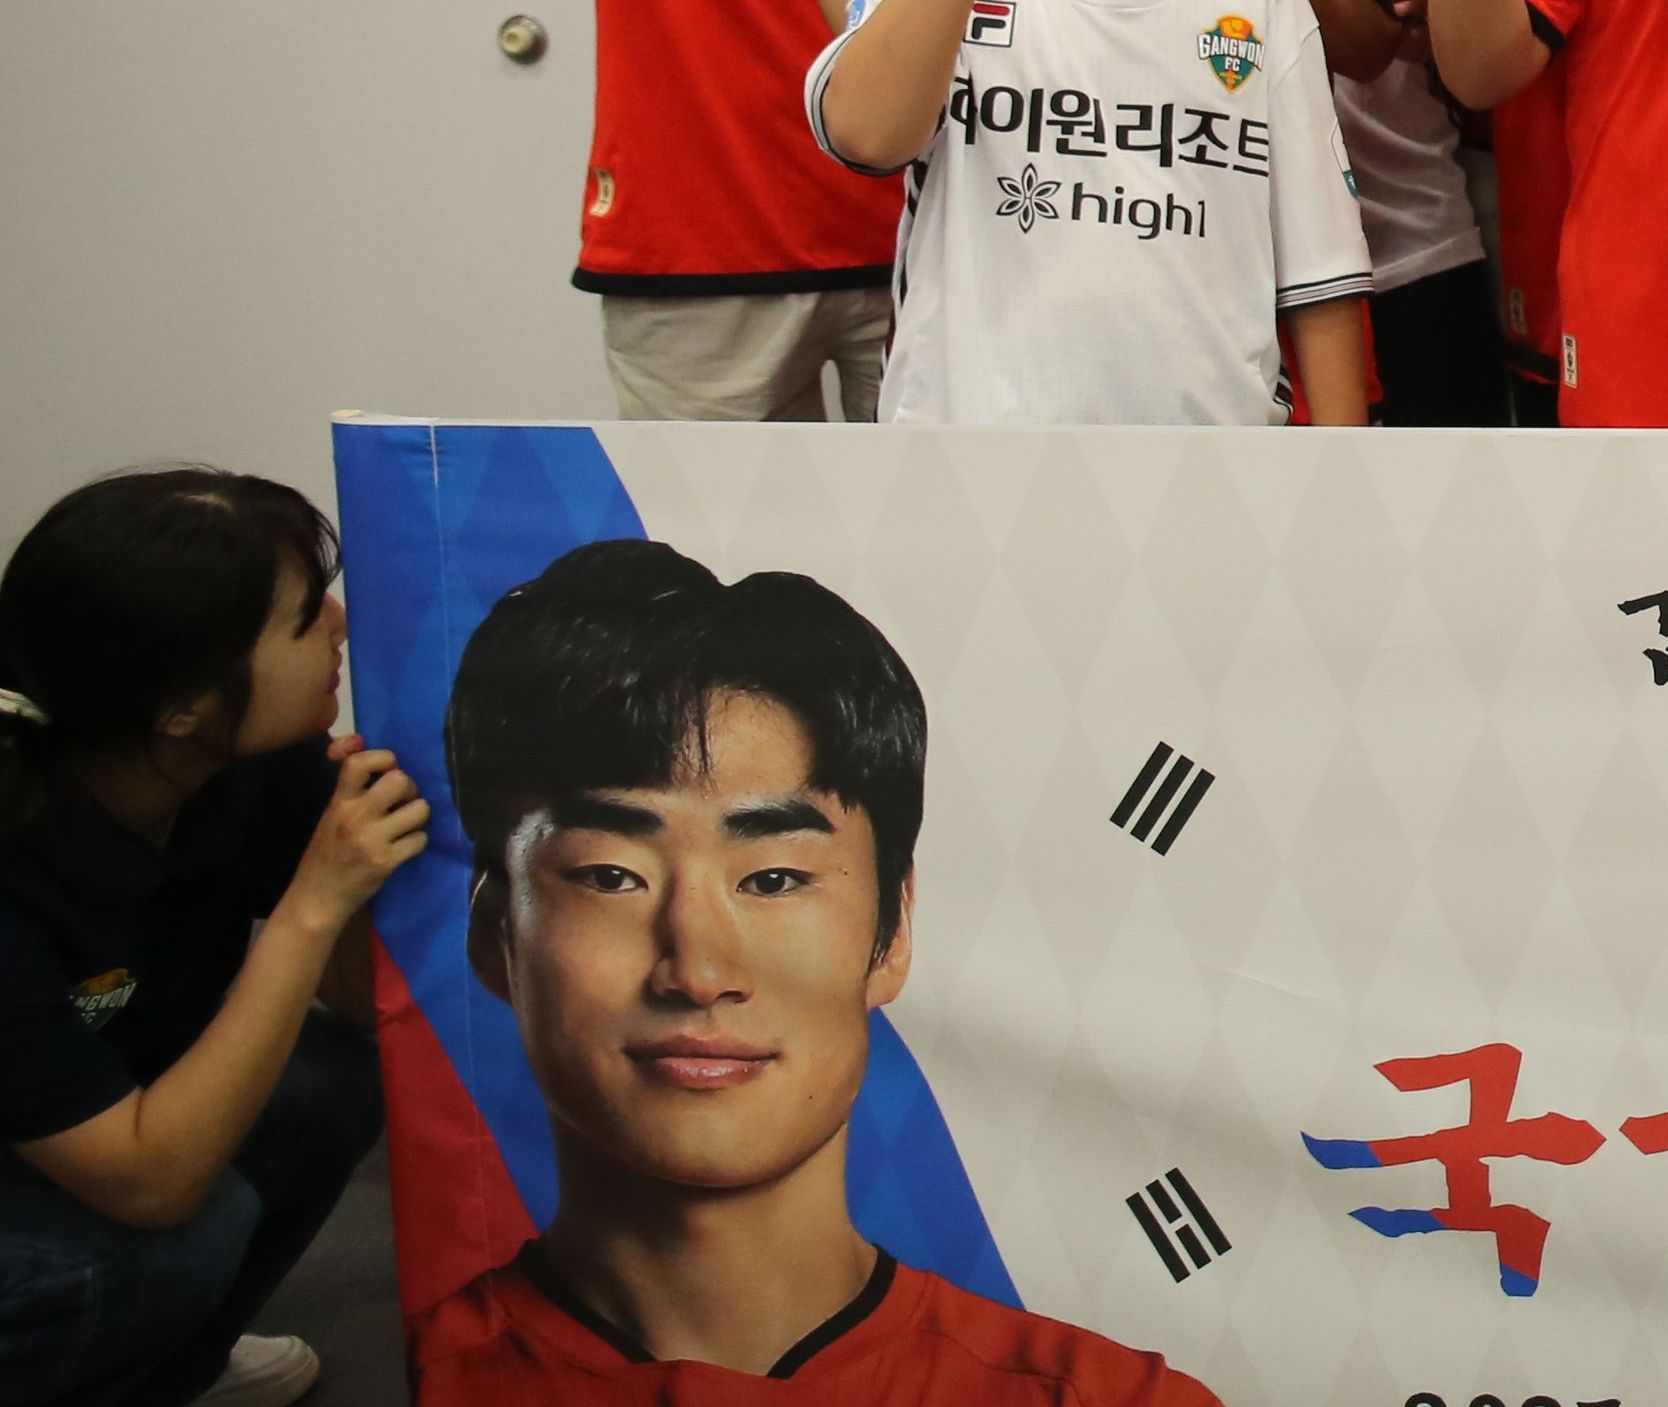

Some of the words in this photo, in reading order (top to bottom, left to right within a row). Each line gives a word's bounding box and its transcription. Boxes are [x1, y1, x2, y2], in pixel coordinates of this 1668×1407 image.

[1197, 32, 1265, 70] GANGWON
[1225, 56, 1240, 72] FC
[1071, 182, 1206, 240] high1
